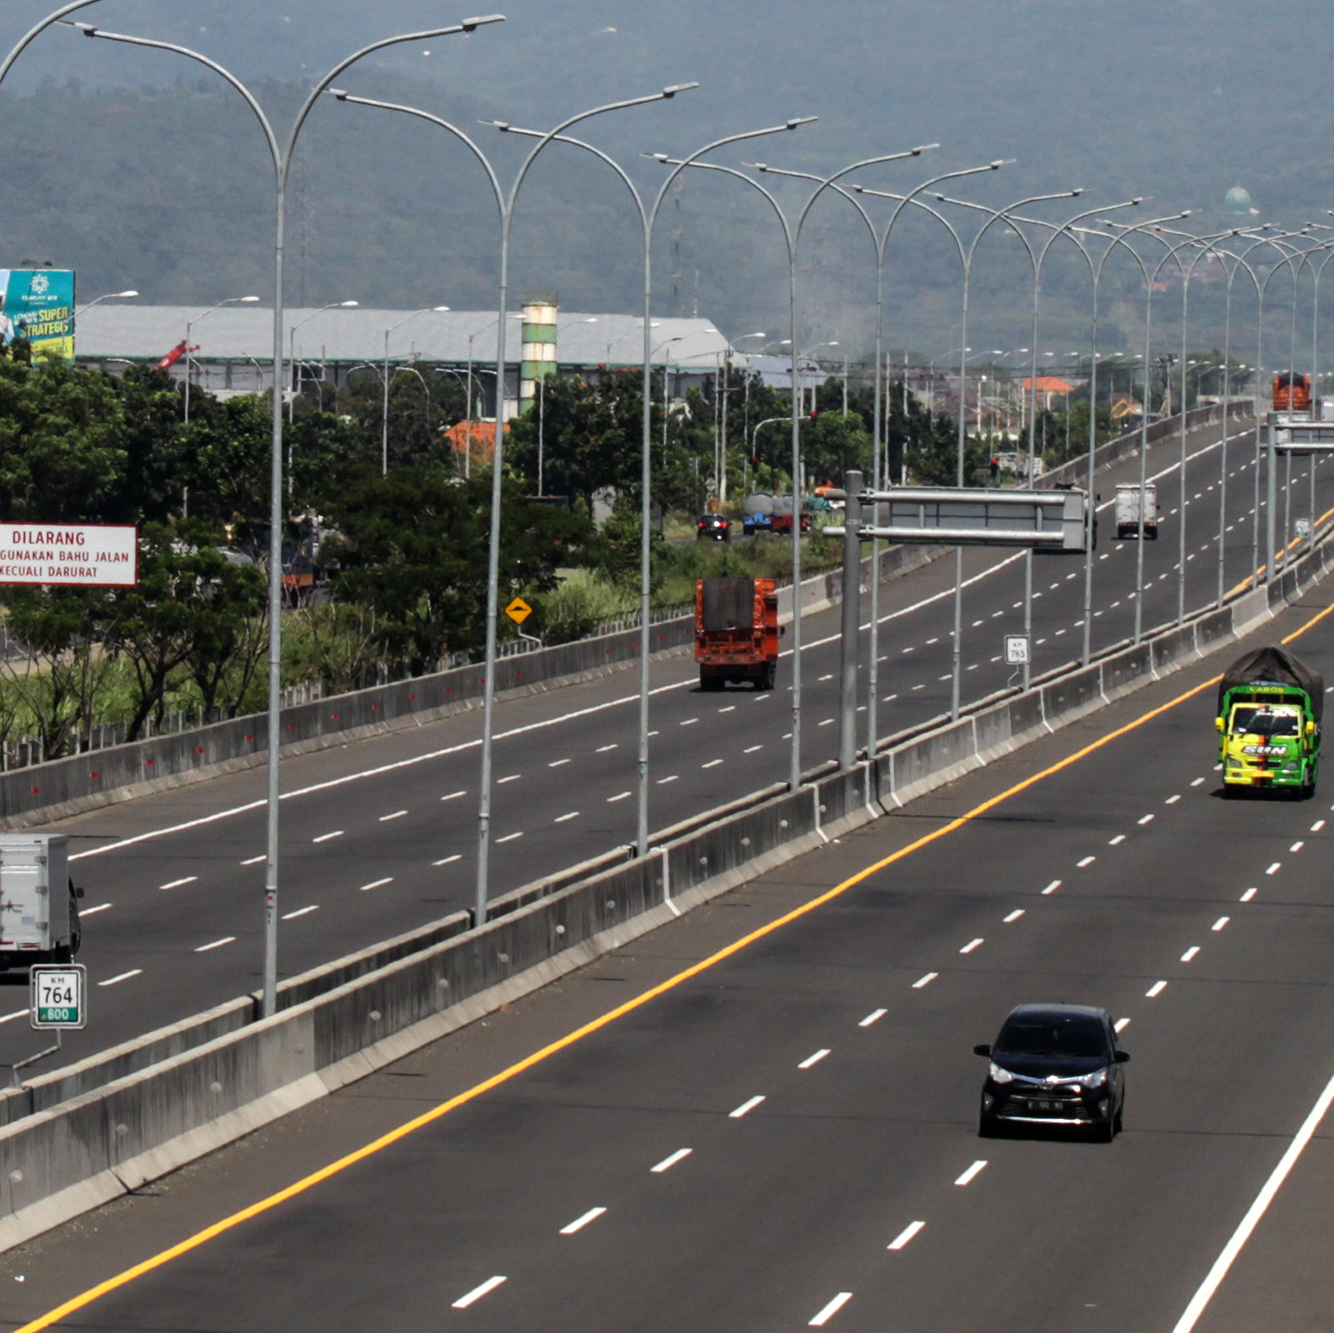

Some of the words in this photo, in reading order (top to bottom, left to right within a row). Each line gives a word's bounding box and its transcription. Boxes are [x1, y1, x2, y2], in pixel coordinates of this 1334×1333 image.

[38, 306, 69, 321] SUPER
[21, 320, 69, 337] STRATEGIS
[12, 530, 85, 545] DILARANG
[59, 551, 89, 562] BAHU
[95, 552, 129, 562] JALAN
[48, 566, 97, 578] DARURAT
[43, 987, 73, 1004] 764
[47, 1008, 69, 1020] 800
